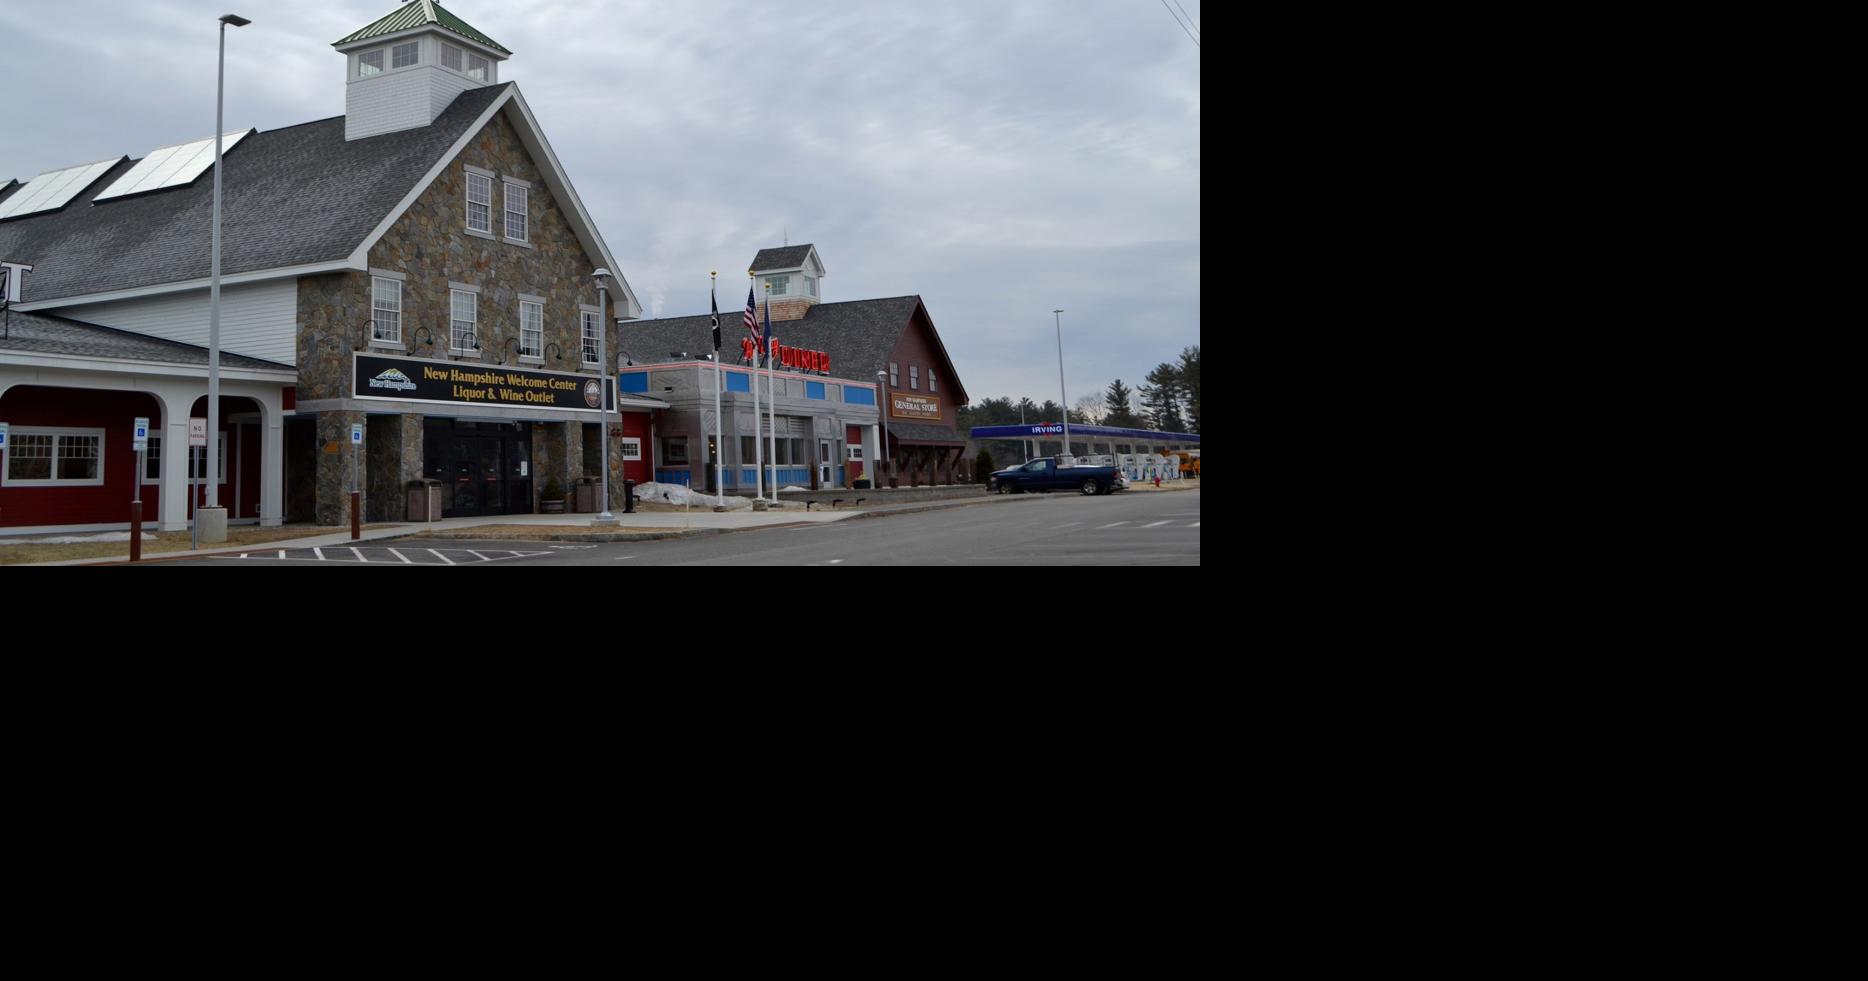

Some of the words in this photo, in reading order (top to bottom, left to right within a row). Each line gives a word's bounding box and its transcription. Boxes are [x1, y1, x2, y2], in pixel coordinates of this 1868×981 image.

[423, 366, 448, 381] New
[450, 369, 504, 386] Hampshire
[506, 374, 548, 388] Welcome
[549, 378, 577, 391] Center
[453, 384, 486, 401] Liquor
[487, 387, 497, 399] &
[499, 388, 526, 402] Wine
[526, 391, 555, 403] Outlet
[894, 399, 921, 411] GENERAL
[921, 403, 938, 412] STORE
[1031, 425, 1063, 433] IRVING
